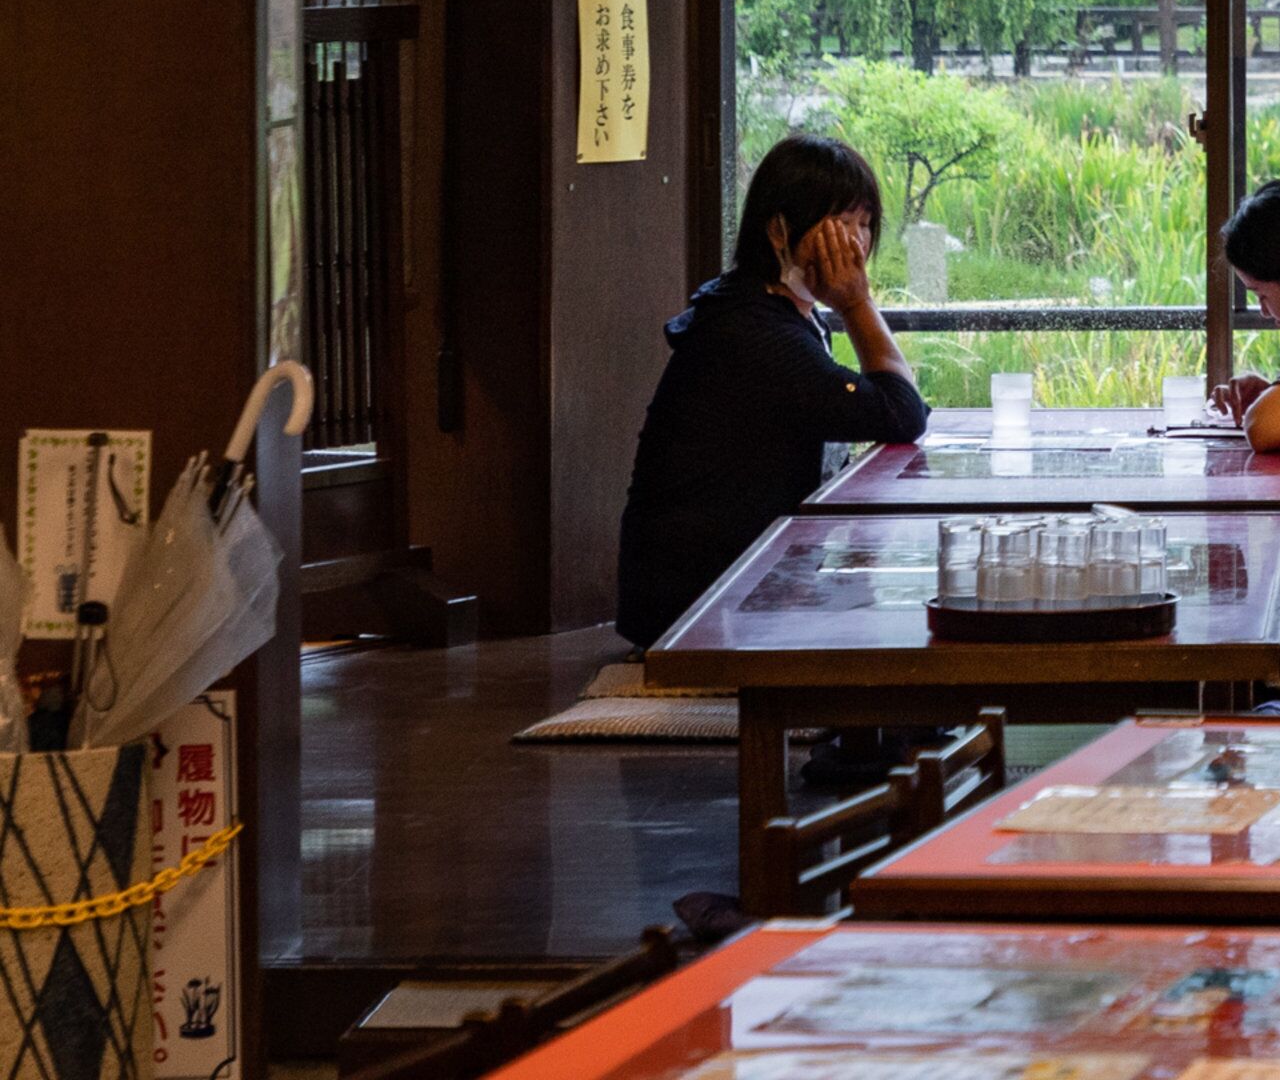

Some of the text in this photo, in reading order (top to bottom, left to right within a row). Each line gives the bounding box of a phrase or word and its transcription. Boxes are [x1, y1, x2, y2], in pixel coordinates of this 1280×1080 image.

[594, 3, 611, 148] お求め下さい
[620, 3, 637, 121] 食事券を
